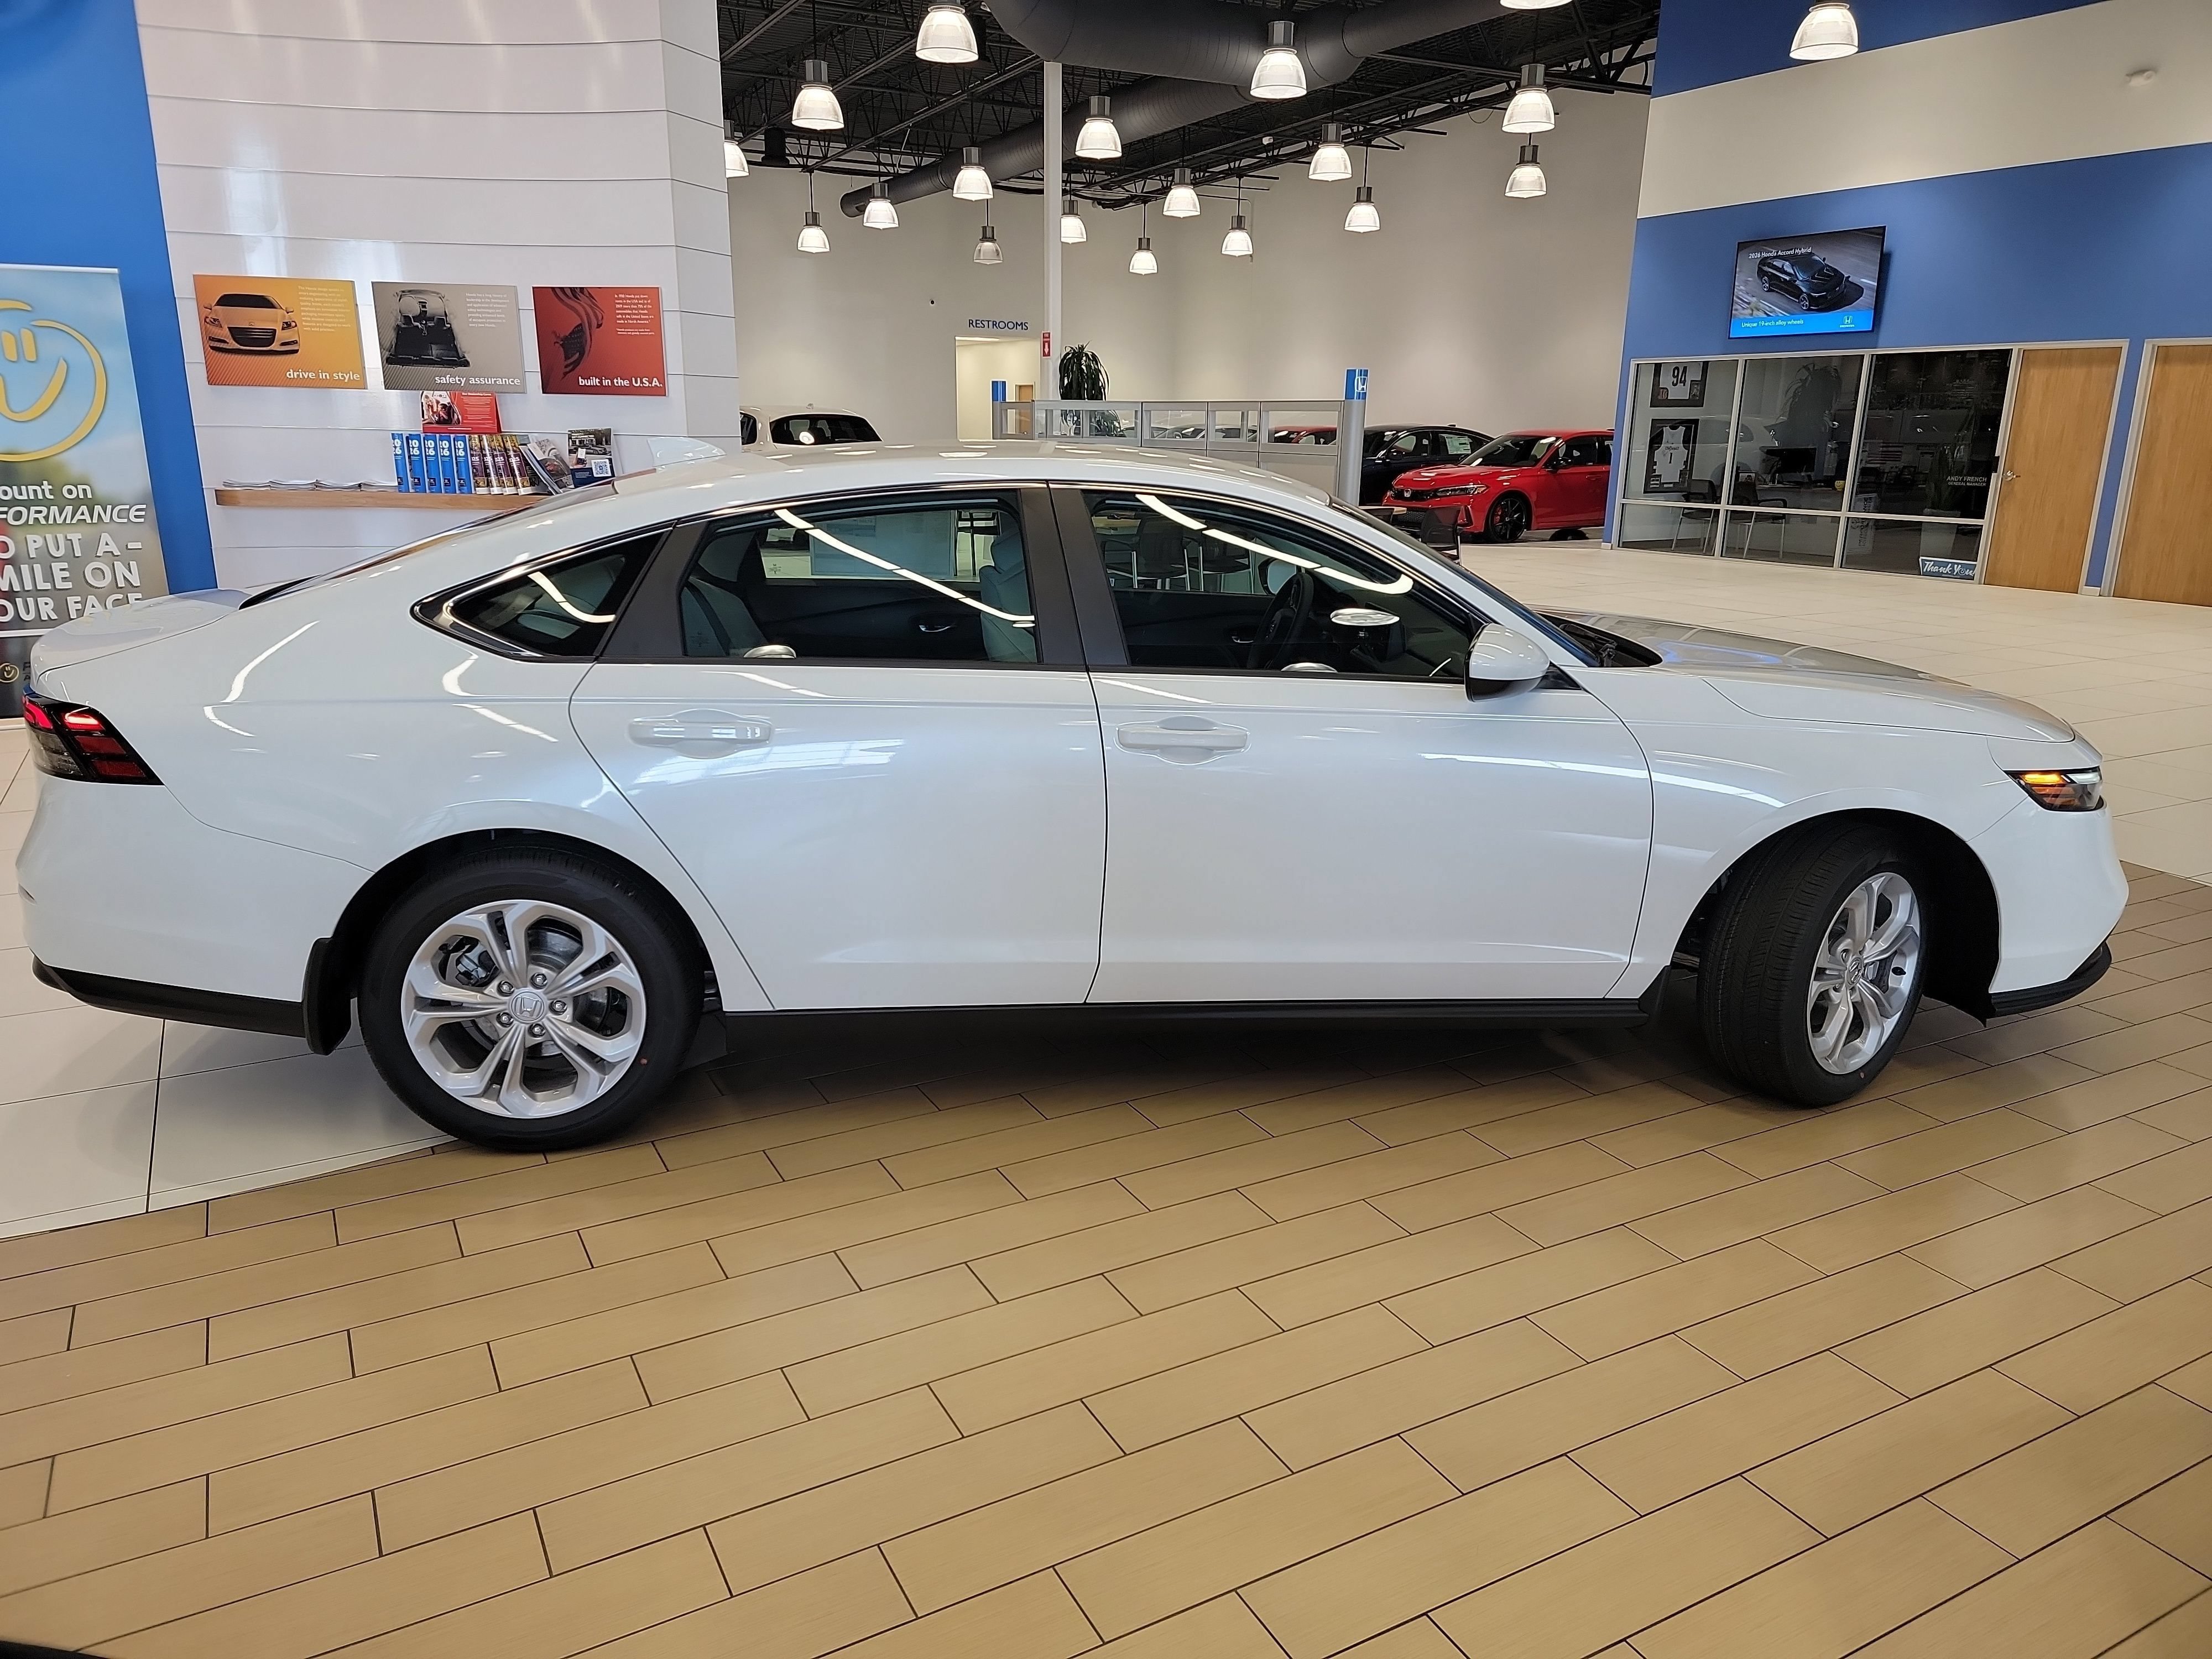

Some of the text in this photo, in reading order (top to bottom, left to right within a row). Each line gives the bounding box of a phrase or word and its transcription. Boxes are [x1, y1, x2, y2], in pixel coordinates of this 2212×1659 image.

[968, 319, 1029, 331] RESTROOMS
[286, 369, 361, 382] drive in style
[435, 374, 521, 386] safety assurance
[578, 376, 663, 387] built in the U.S.A.
[1672, 366, 1688, 387] 94
[1669, 452, 1673, 464] 1
[62, 484, 92, 499] on
[26, 533, 82, 558] PUT
[95, 533, 121, 557] A
[1923, 561, 1953, 573] Thank
[84, 561, 141, 588] ON
